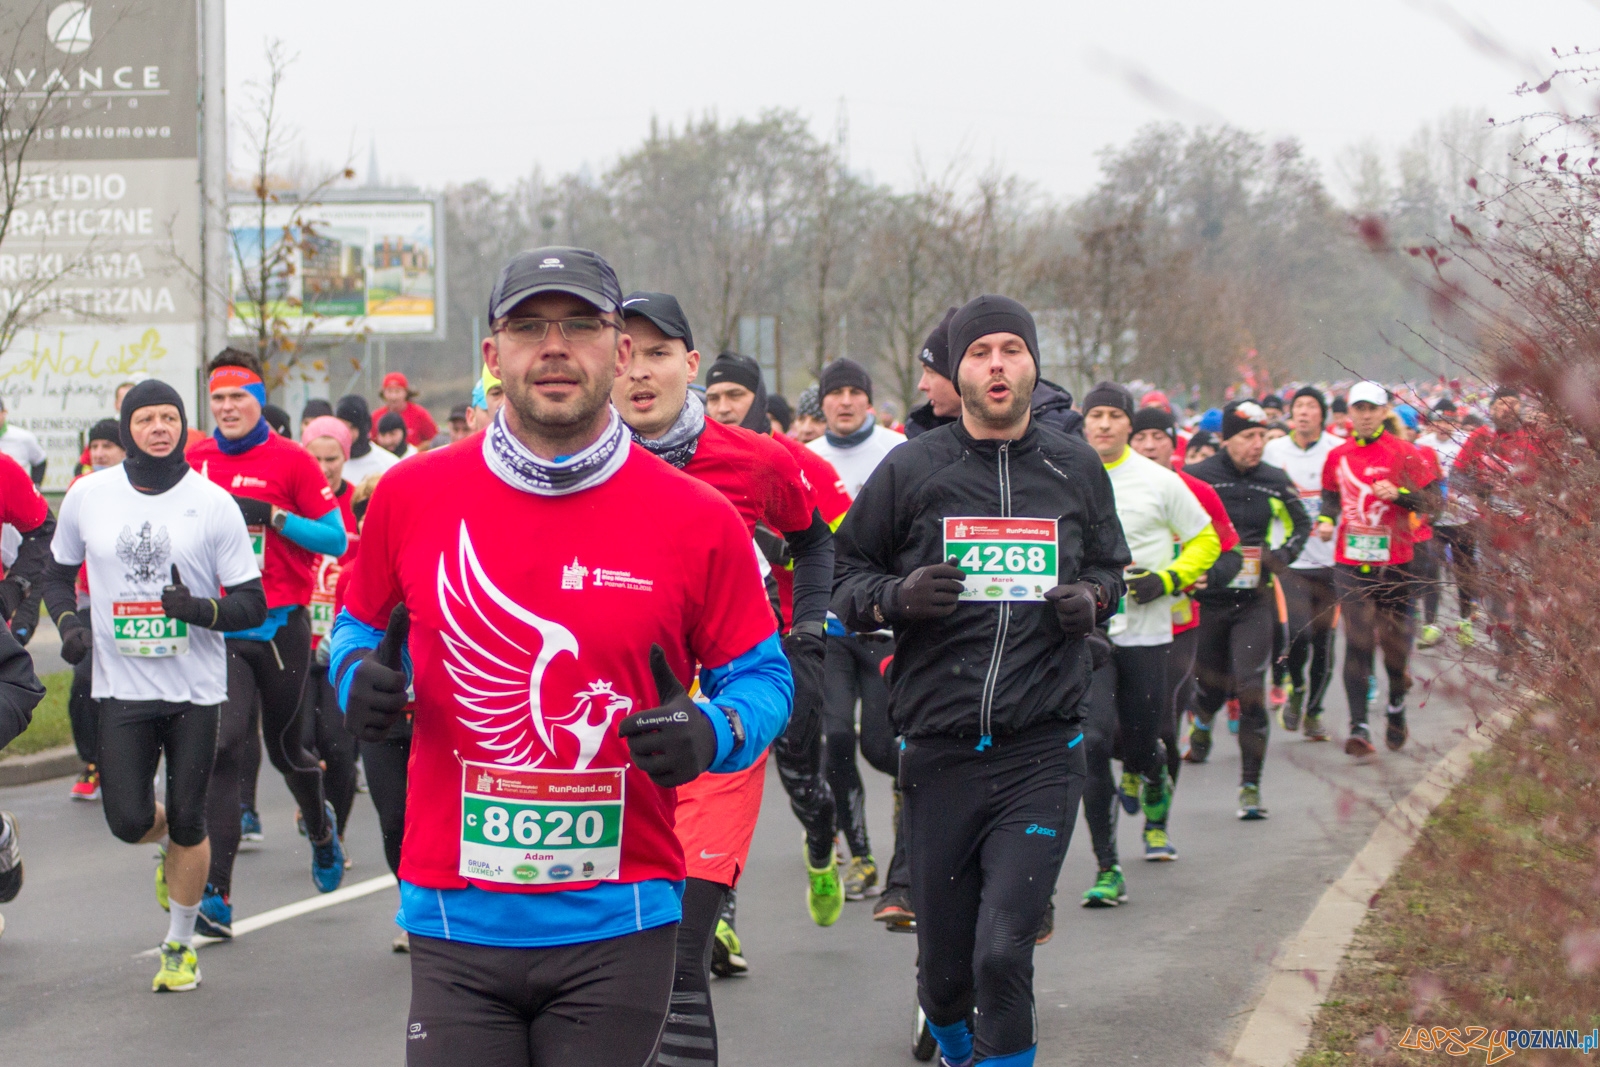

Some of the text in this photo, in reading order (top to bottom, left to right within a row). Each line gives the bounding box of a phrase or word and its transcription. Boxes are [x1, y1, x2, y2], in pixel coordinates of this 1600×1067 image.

[60, 125, 171, 139] Reklamowa
[17, 173, 127, 201] STUDIO
[0, 207, 154, 236] RAFICZNE
[1006, 528, 1050, 536] RunPoland.org
[960, 546, 1046, 572] 4268
[122, 618, 177, 638] 4201
[636, 715, 672, 727] Kalenji
[549, 785, 612, 793] RunPoland.org
[482, 806, 604, 845] 8620
[1036, 826, 1057, 837] asics
[524, 853, 554, 861] Adam
[468, 859, 490, 869] GRUPA
[467, 866, 494, 877] LUXMED
